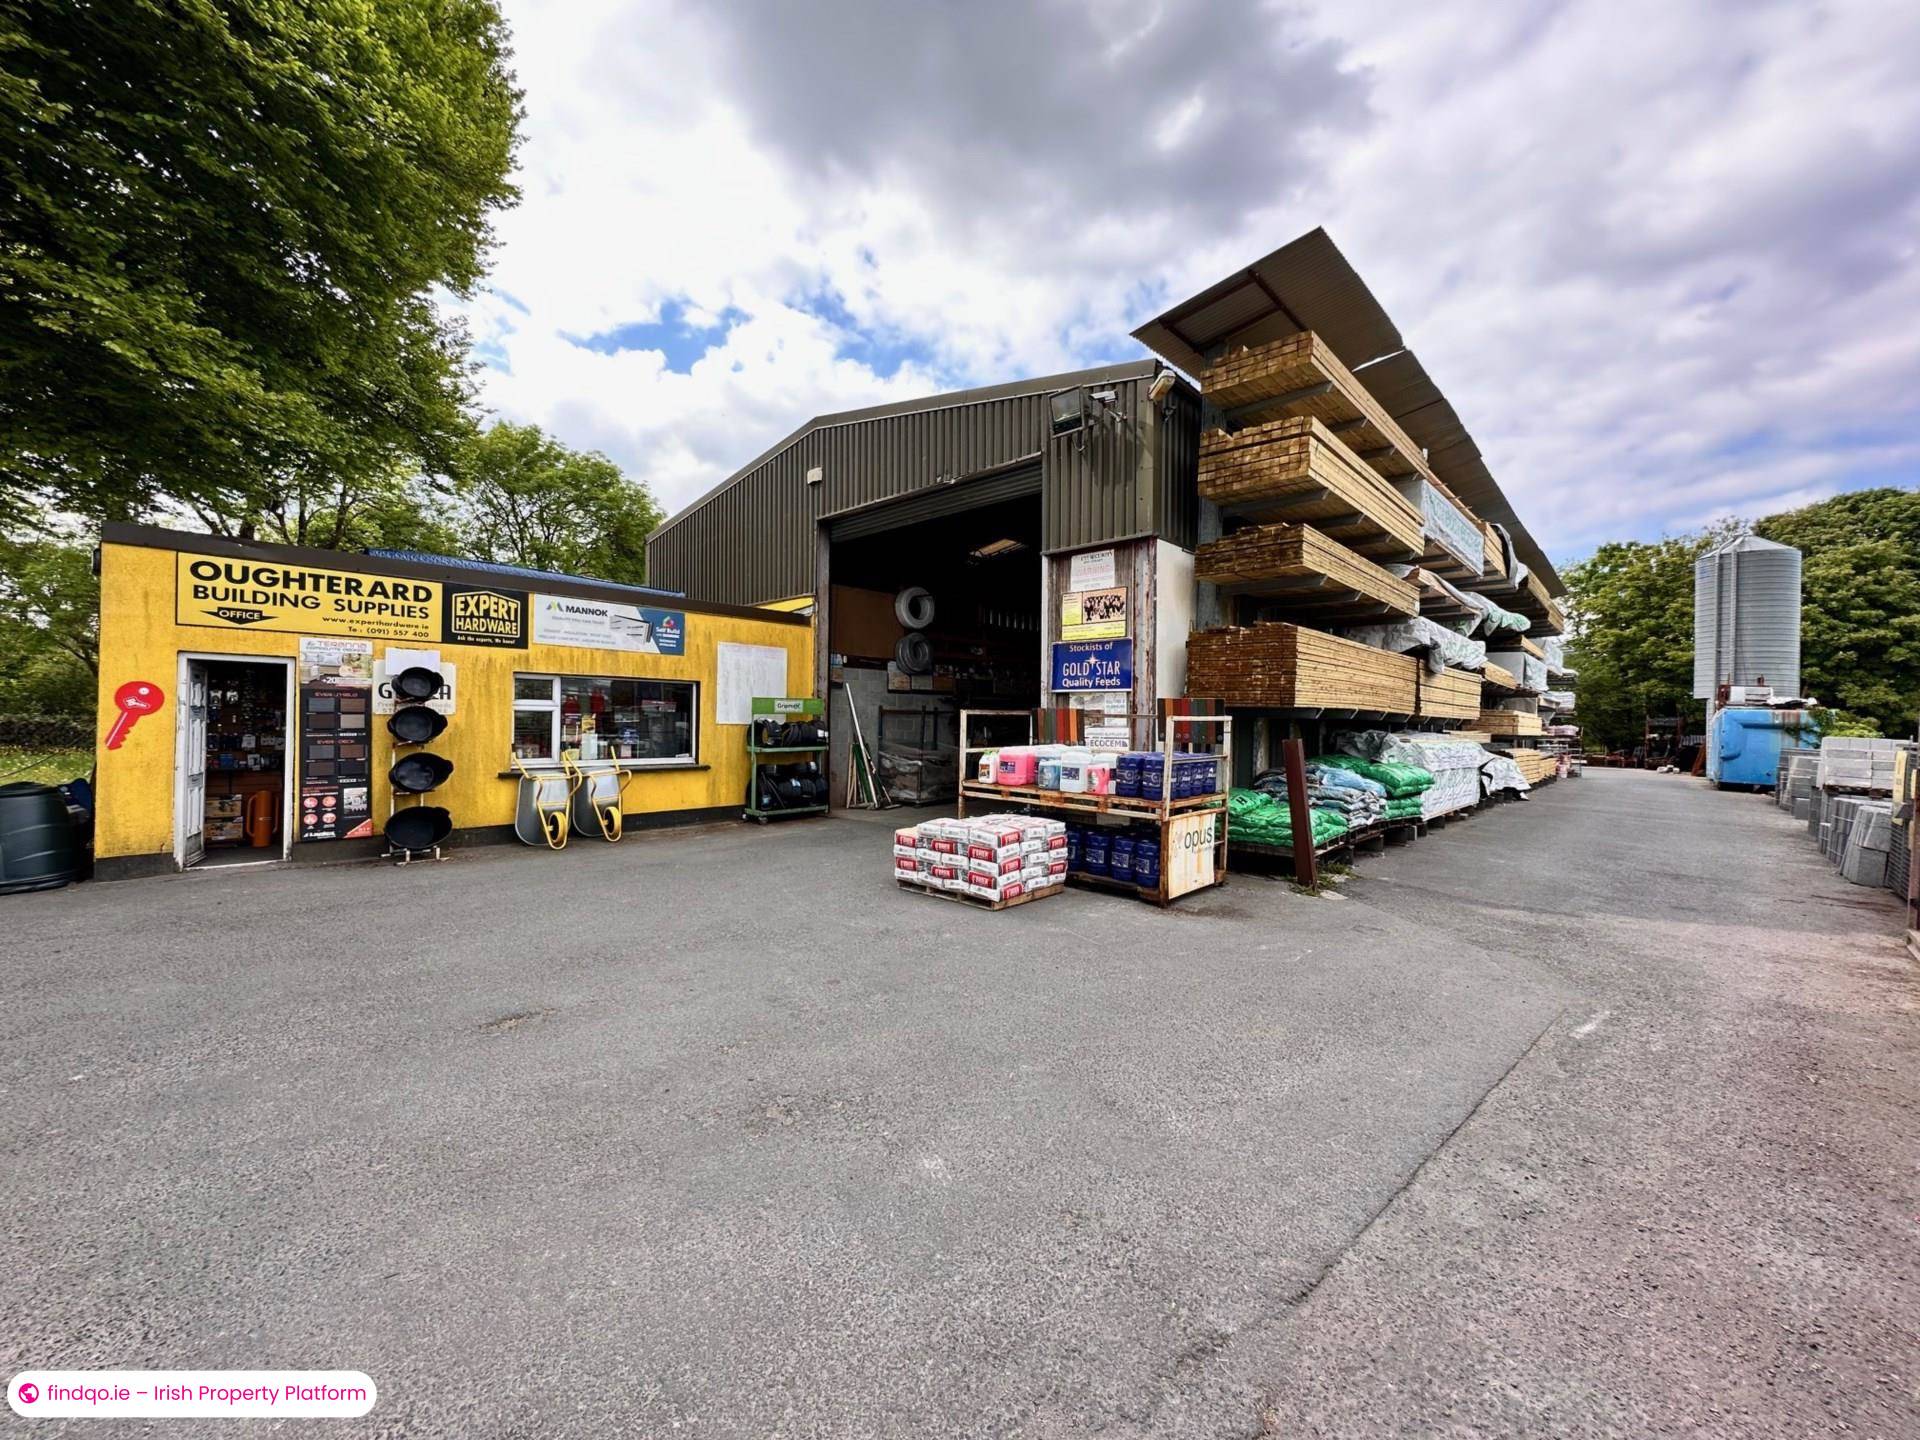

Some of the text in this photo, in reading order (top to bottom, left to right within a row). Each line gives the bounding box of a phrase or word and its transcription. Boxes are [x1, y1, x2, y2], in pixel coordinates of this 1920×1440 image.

[190, 560, 433, 603] OUGHTERARD
[193, 584, 430, 619] BUILDING SUPPLIES
[456, 595, 517, 620] EXPERT
[219, 609, 261, 620] OFFICE
[565, 605, 608, 617] MANNOK
[322, 616, 429, 630] www.experthardwareie
[456, 617, 517, 634] HARDWARE
[367, 627, 390, 636] (091)
[393, 629, 408, 637] 557
[1069, 642, 1113, 652] Stockists of
[1062, 661, 1121, 676] GOLD STAR
[1062, 676, 1121, 688] Quality Feeds
[1090, 739, 1121, 748] ECOCEM
[1184, 826, 1213, 854] opus
